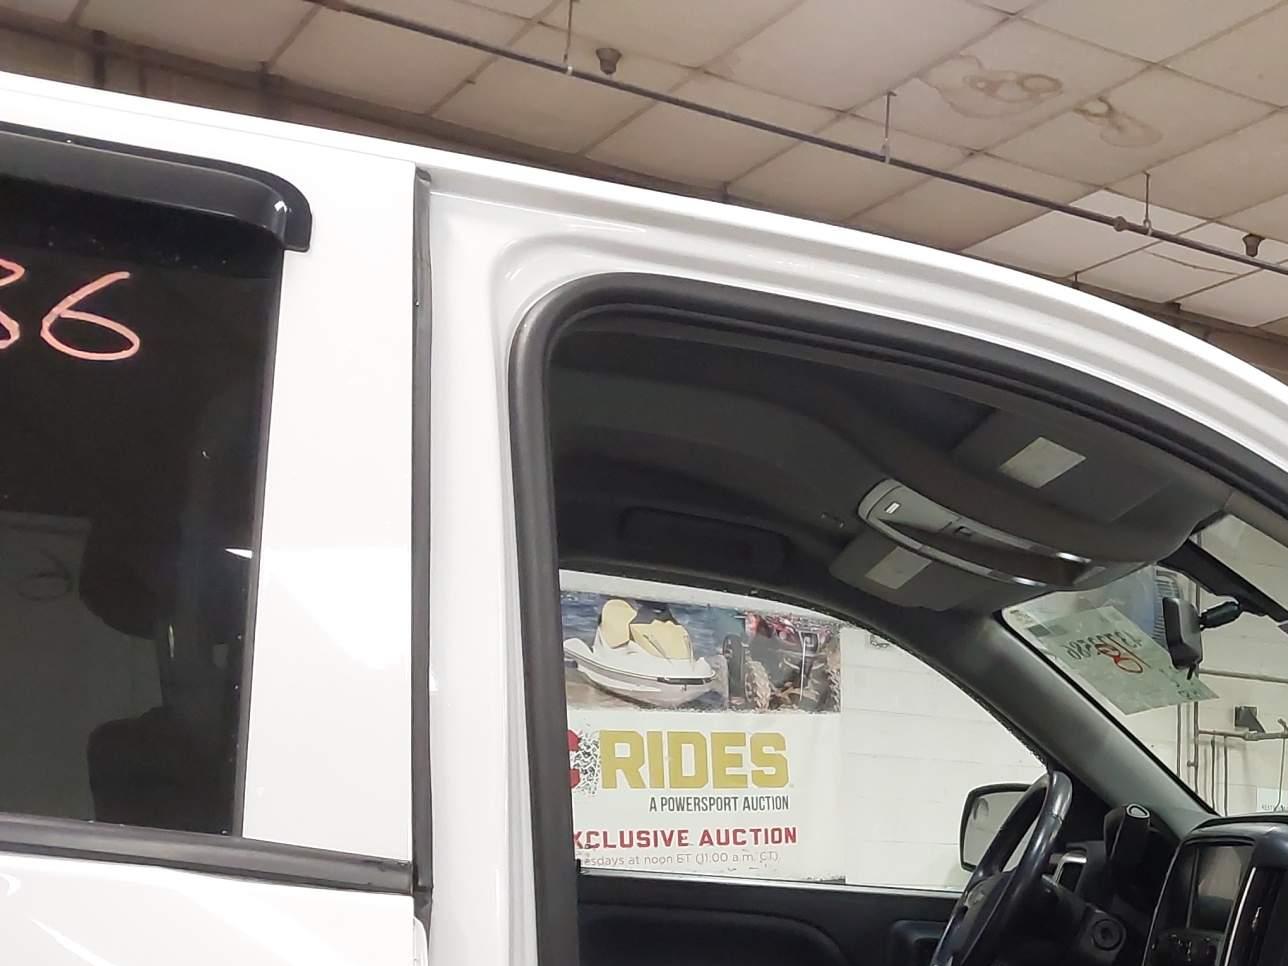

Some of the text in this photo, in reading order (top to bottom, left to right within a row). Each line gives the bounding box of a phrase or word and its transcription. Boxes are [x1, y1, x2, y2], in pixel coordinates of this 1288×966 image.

[599, 729, 790, 789] RIDES
[649, 795, 790, 812] A POWERSPORT AUCTION
[699, 826, 798, 847] AUCTION
[628, 855, 641, 865] at
[644, 855, 673, 865] noon
